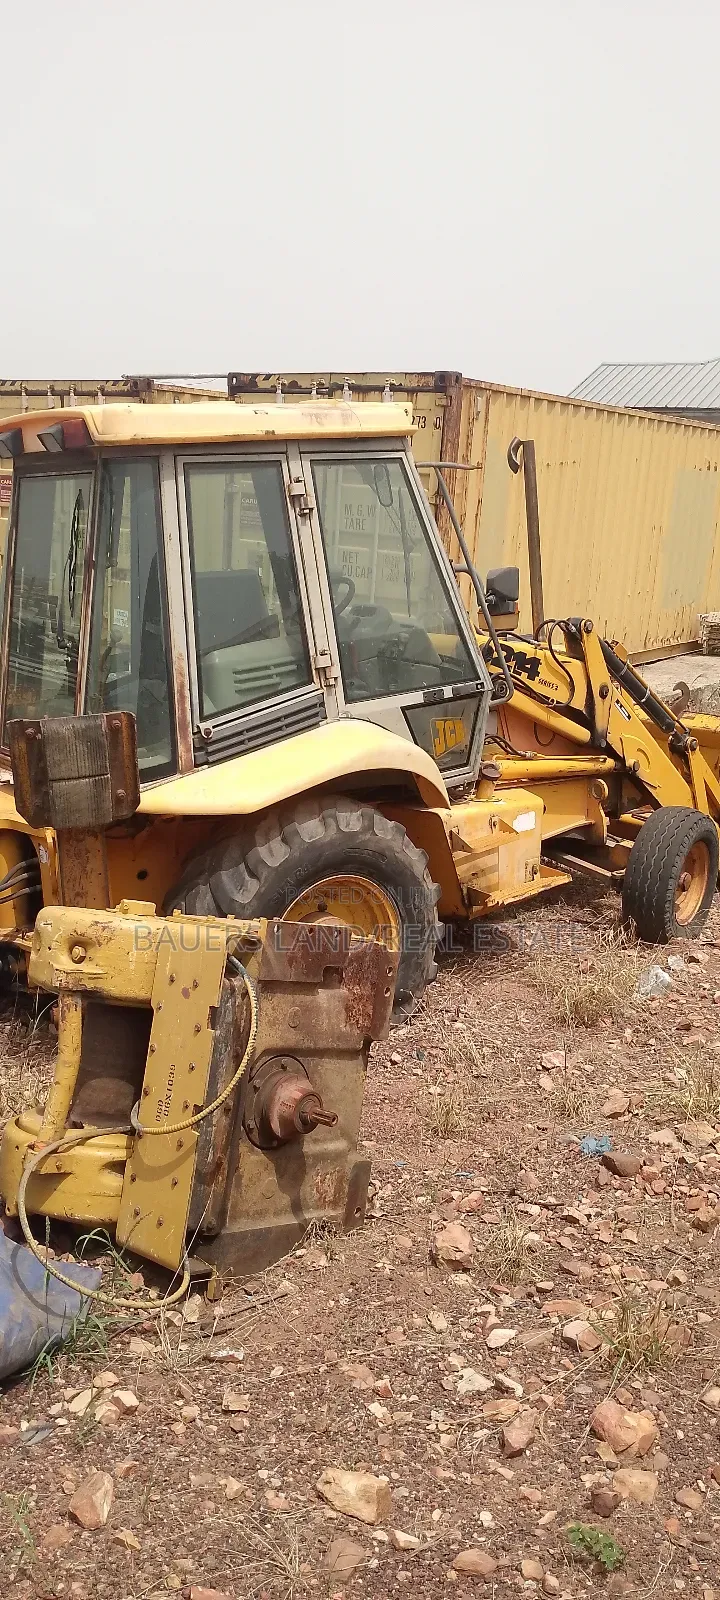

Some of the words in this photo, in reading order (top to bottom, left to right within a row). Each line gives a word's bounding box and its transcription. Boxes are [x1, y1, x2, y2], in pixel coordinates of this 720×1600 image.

[344, 518, 367, 531] TARE
[342, 551, 360, 564] NET
[434, 719, 465, 757] JCB
